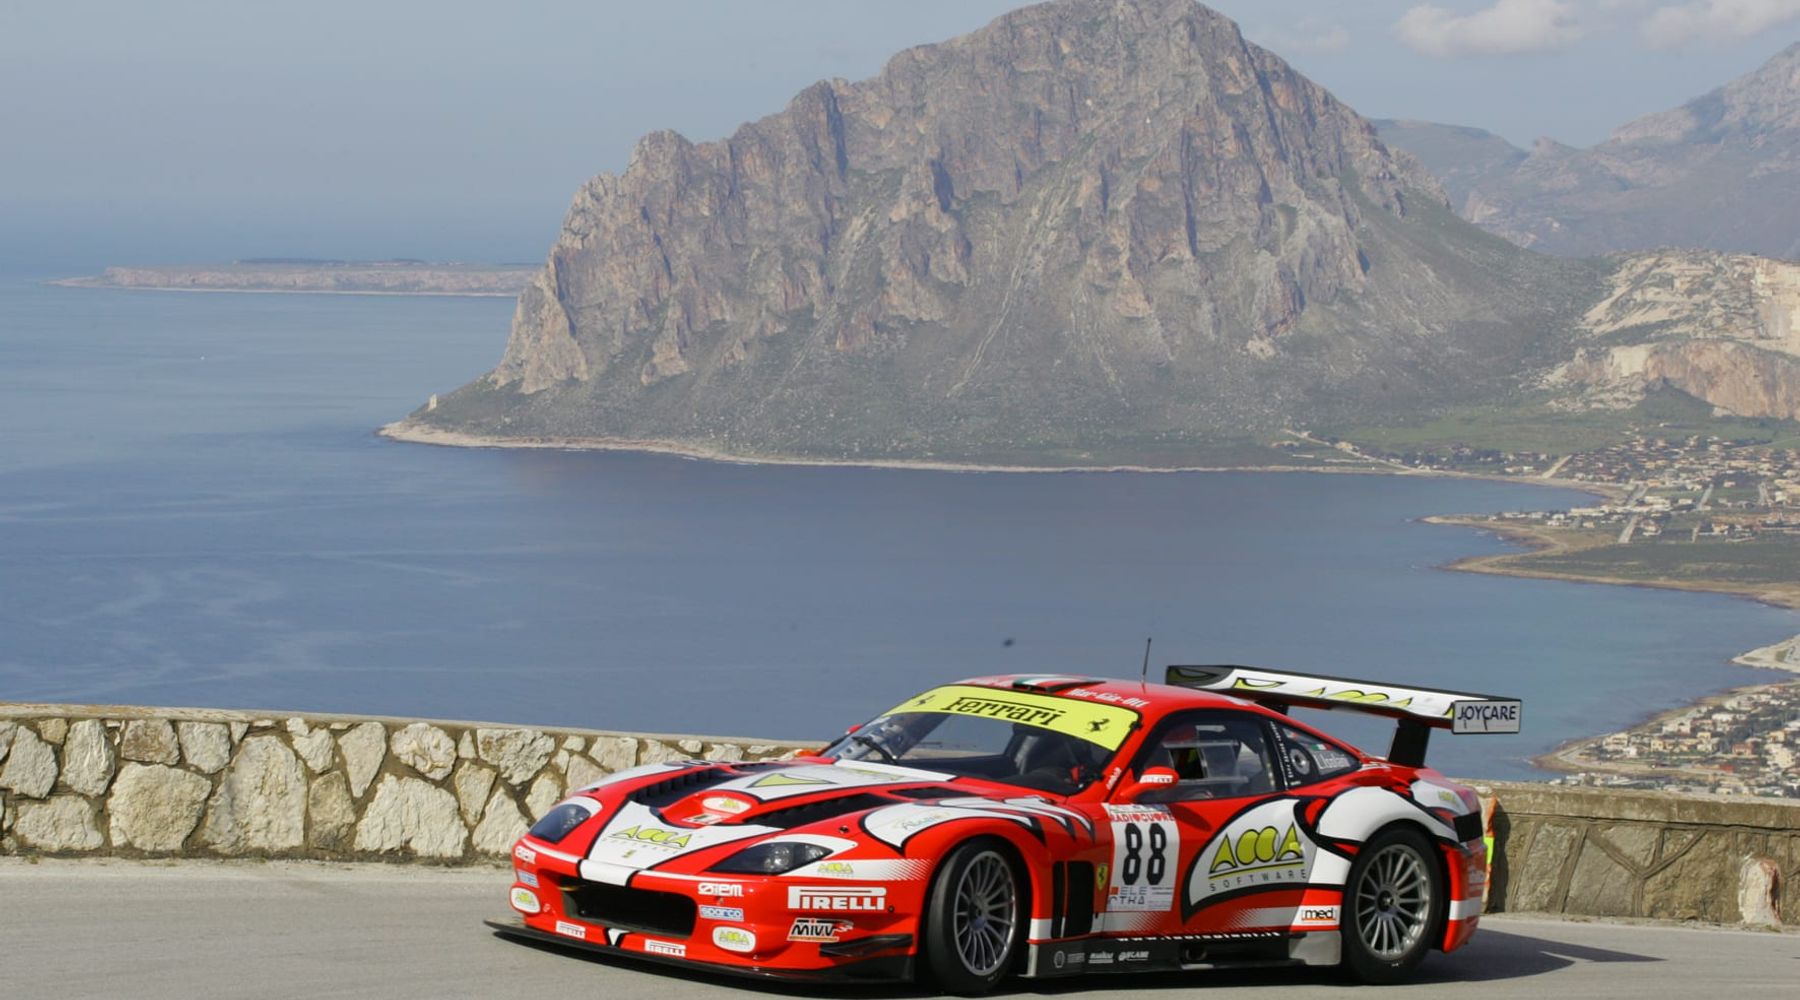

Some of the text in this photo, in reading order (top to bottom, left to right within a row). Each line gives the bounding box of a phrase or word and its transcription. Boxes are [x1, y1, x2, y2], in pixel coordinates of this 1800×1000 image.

[941, 697, 1066, 725] Ferrari
[1457, 705, 1516, 721] JOYCARE
[611, 825, 693, 848] ACCA
[1209, 821, 1304, 874] ACCA
[1122, 822, 1167, 886] 88
[1209, 868, 1307, 892] SOFTWARE
[788, 886, 887, 910] PIRELLI
